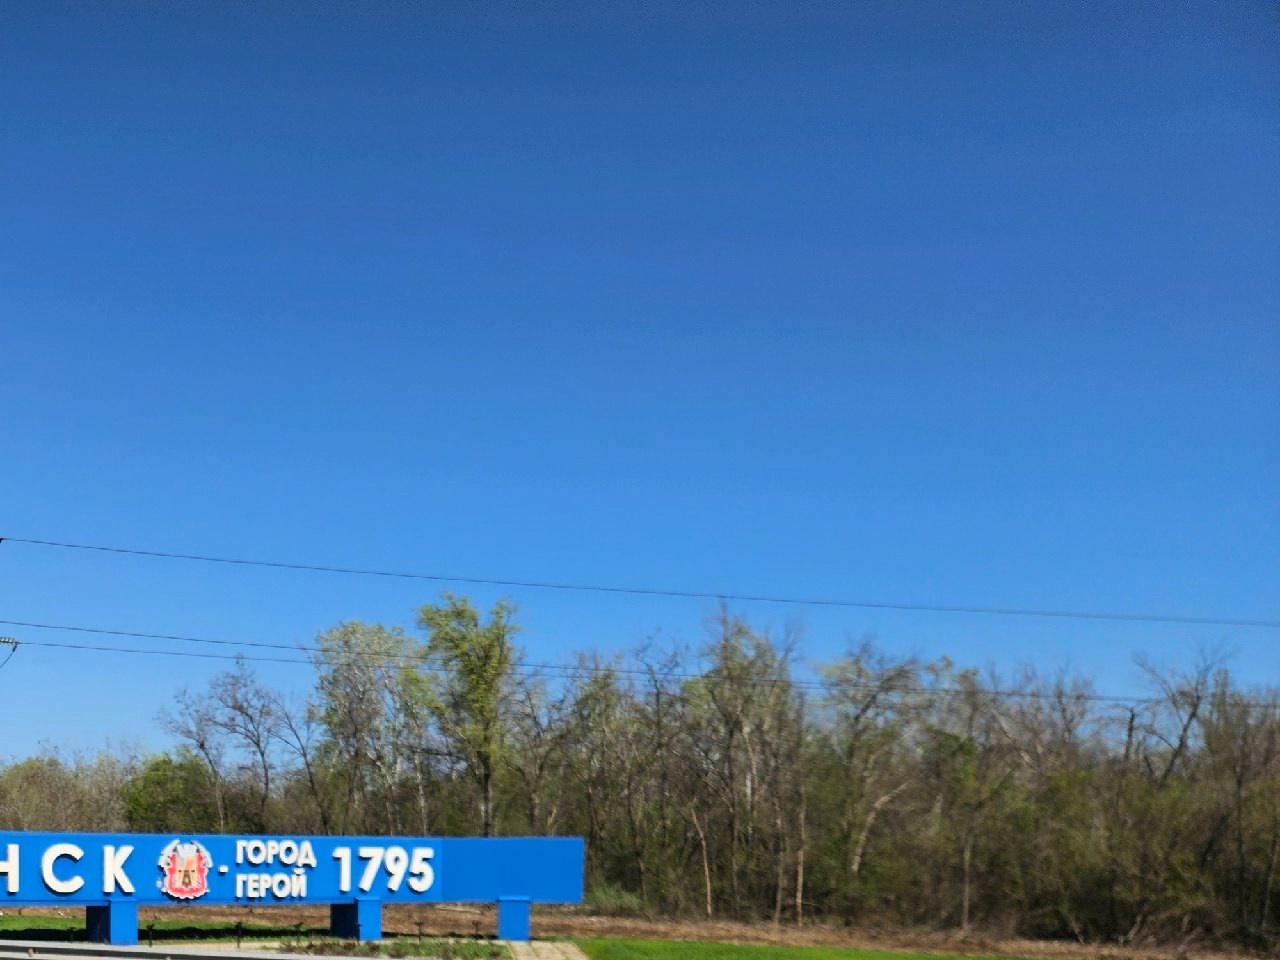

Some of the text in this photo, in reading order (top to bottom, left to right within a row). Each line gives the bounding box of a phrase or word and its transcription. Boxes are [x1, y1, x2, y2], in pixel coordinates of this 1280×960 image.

[236, 839, 317, 868] ГОРОД
[236, 868, 307, 898] ГЕРОЙ
[332, 846, 434, 892] 1795
